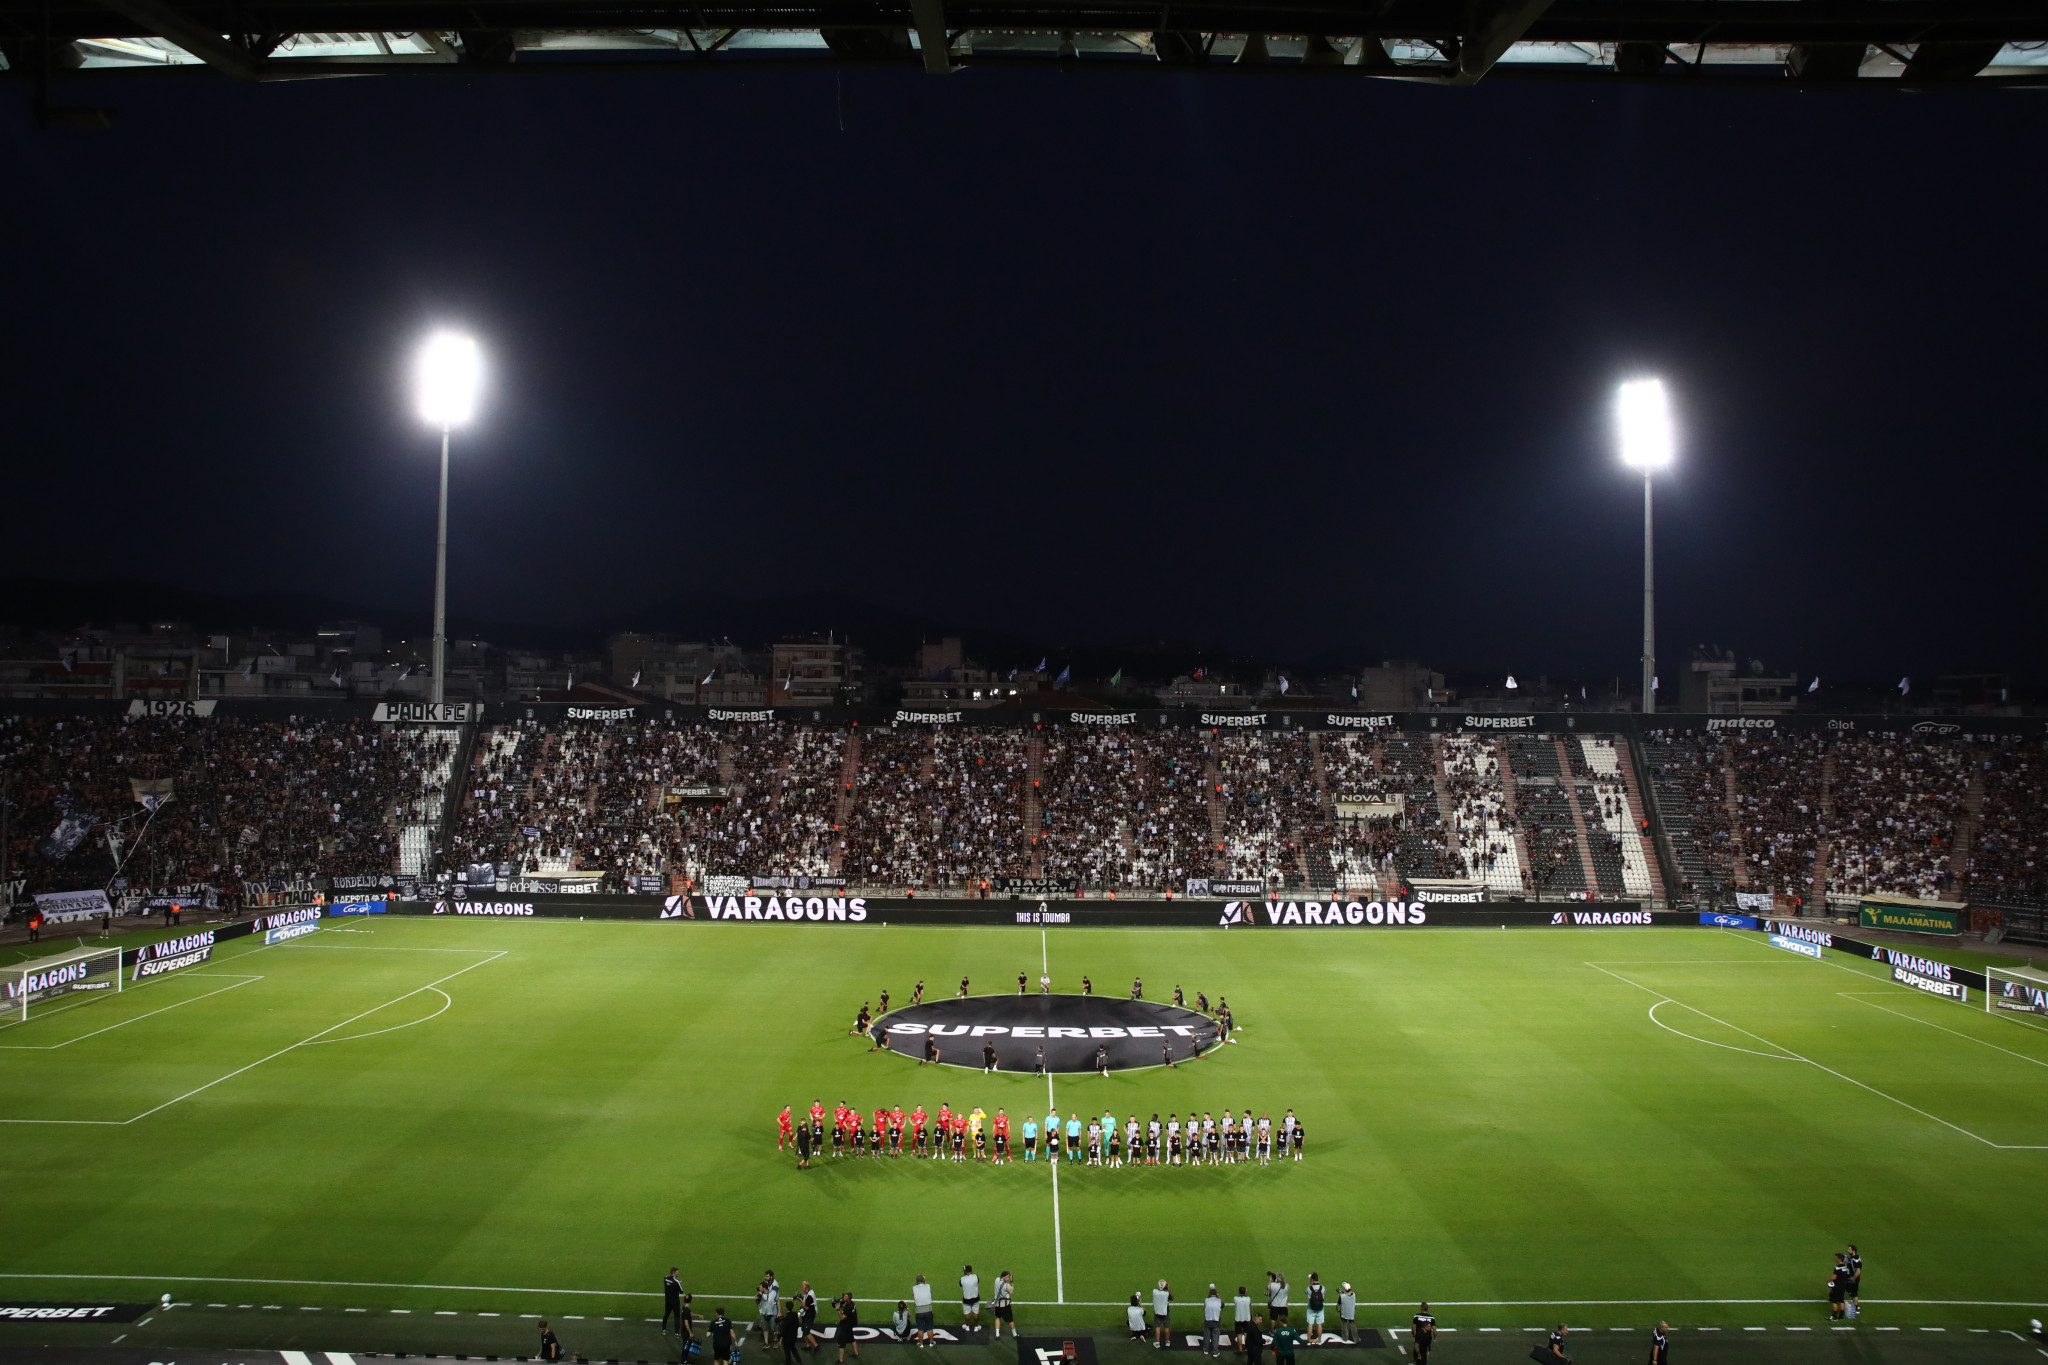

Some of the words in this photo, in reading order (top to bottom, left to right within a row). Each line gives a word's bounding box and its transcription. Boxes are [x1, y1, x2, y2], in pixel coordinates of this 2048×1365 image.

[144, 700, 196, 717] 1926
[387, 704, 437, 721] PAOK
[443, 705, 466, 721] FC
[567, 707, 635, 721] SUPERBET
[708, 708, 775, 723] SUPERBET
[896, 710, 962, 724] SUPERBET
[1070, 712, 1137, 726] SUPERBET
[1201, 713, 1267, 727] SUPERBET
[1327, 714, 1393, 728] SUPERBET
[1465, 714, 1535, 729] SUPERBET
[1706, 718, 1775, 730] mateco
[671, 787, 711, 796] SUPERBET
[1341, 794, 1381, 802] NOVA
[815, 878, 847, 886] GIANNITSA
[1227, 884, 1261, 893] ΓΡΕΒΕΝΑ
[1417, 891, 1484, 903] SUPERBET
[454, 902, 534, 916] VARAGONS
[704, 896, 868, 921] VARAGONS
[1265, 901, 1426, 926] VARAGONS
[266, 907, 322, 929] VARAGONS
[1016, 911, 1031, 923] THIS
[1032, 911, 1040, 923] IS
[1042, 911, 1070, 923] TOUMBA
[1573, 912, 1652, 925] VARAGONS
[1778, 922, 1833, 948] VARAGONS
[154, 931, 215, 958] VARAGONS
[141, 947, 210, 976] SUPERBET
[1887, 949, 1953, 981] VARAGONS
[1894, 967, 1961, 997] SUPERBET
[886, 1023, 1196, 1038] SUPERBET
[0, 1306, 116, 1319] PERBET
